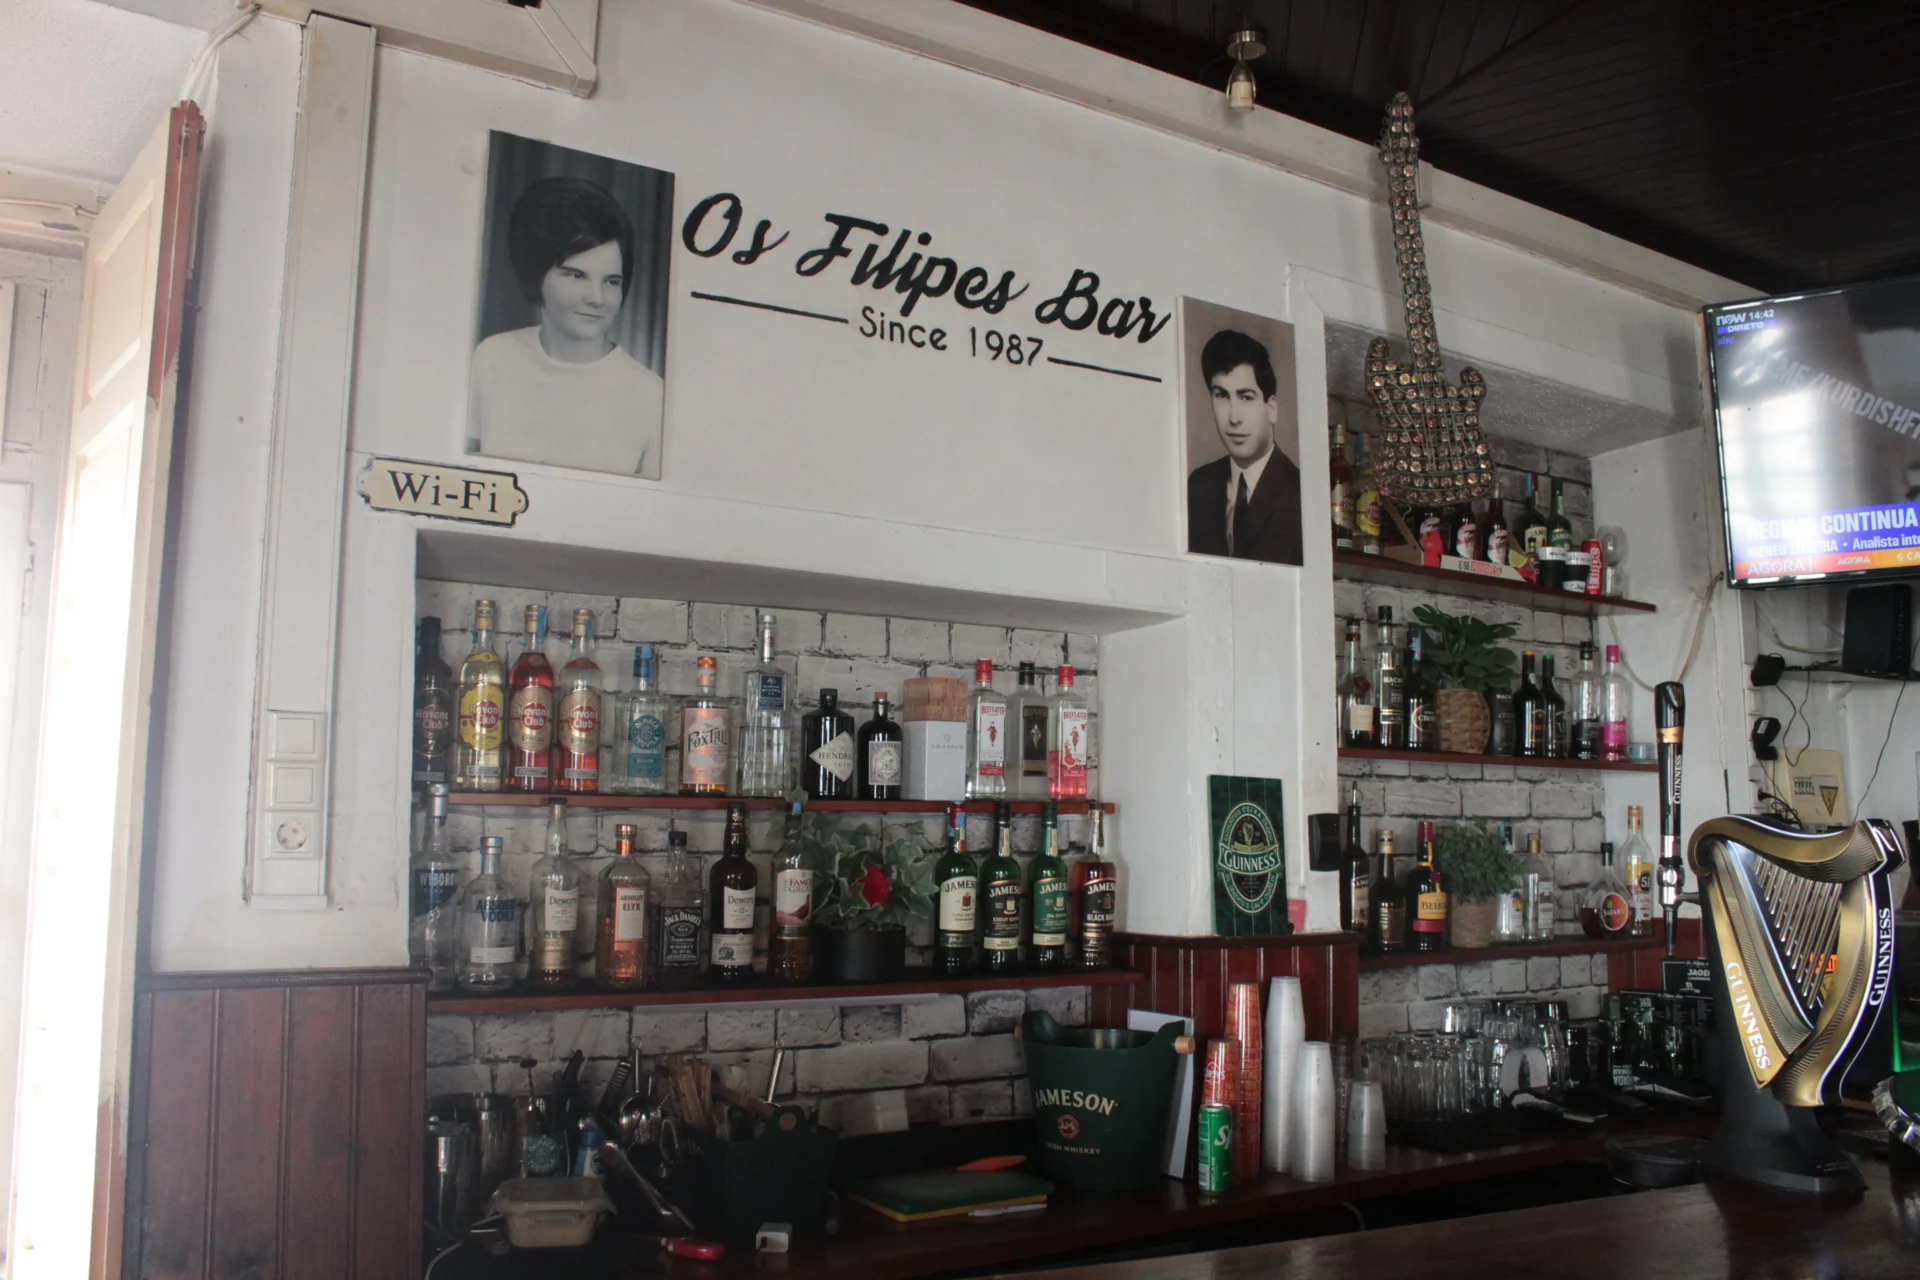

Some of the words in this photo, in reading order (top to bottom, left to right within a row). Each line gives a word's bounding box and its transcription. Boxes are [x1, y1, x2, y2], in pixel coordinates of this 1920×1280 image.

[681, 192, 790, 266] Os
[795, 212, 1030, 317] Filipes
[1035, 268, 1172, 344] Bar
[1749, 309, 1775, 320] 14:42
[1728, 321, 1764, 333] DIRETO
[859, 305, 948, 351] Since
[969, 326, 1044, 366] 1987
[1717, 336, 1735, 345] abc
[387, 470, 499, 514] Wi-Fi
[1821, 507, 1919, 535] CONTINUA
[1853, 536, 1900, 550] Analista
[1747, 557, 1806, 576] AGORA
[1837, 555, 1871, 566] AGORA
[980, 704, 1005, 715] BEEFEATER
[1063, 710, 1087, 720] BEEFEATER
[422, 720, 443, 730] Club
[524, 716, 545, 726] Club
[572, 718, 593, 728] Club
[1672, 754, 1682, 805] GUINNESS
[1223, 849, 1276, 872] GUINNESS
[1640, 876, 1651, 889] 51
[623, 903, 641, 911] ELYX
[1086, 913, 1105, 921] BLACK
[1868, 907, 1892, 1007] GUINNESS
[1726, 961, 1772, 1070] GUINNESS
[1035, 1088, 1116, 1116] JAMESON
[1063, 1145, 1101, 1155] WHISKEY
